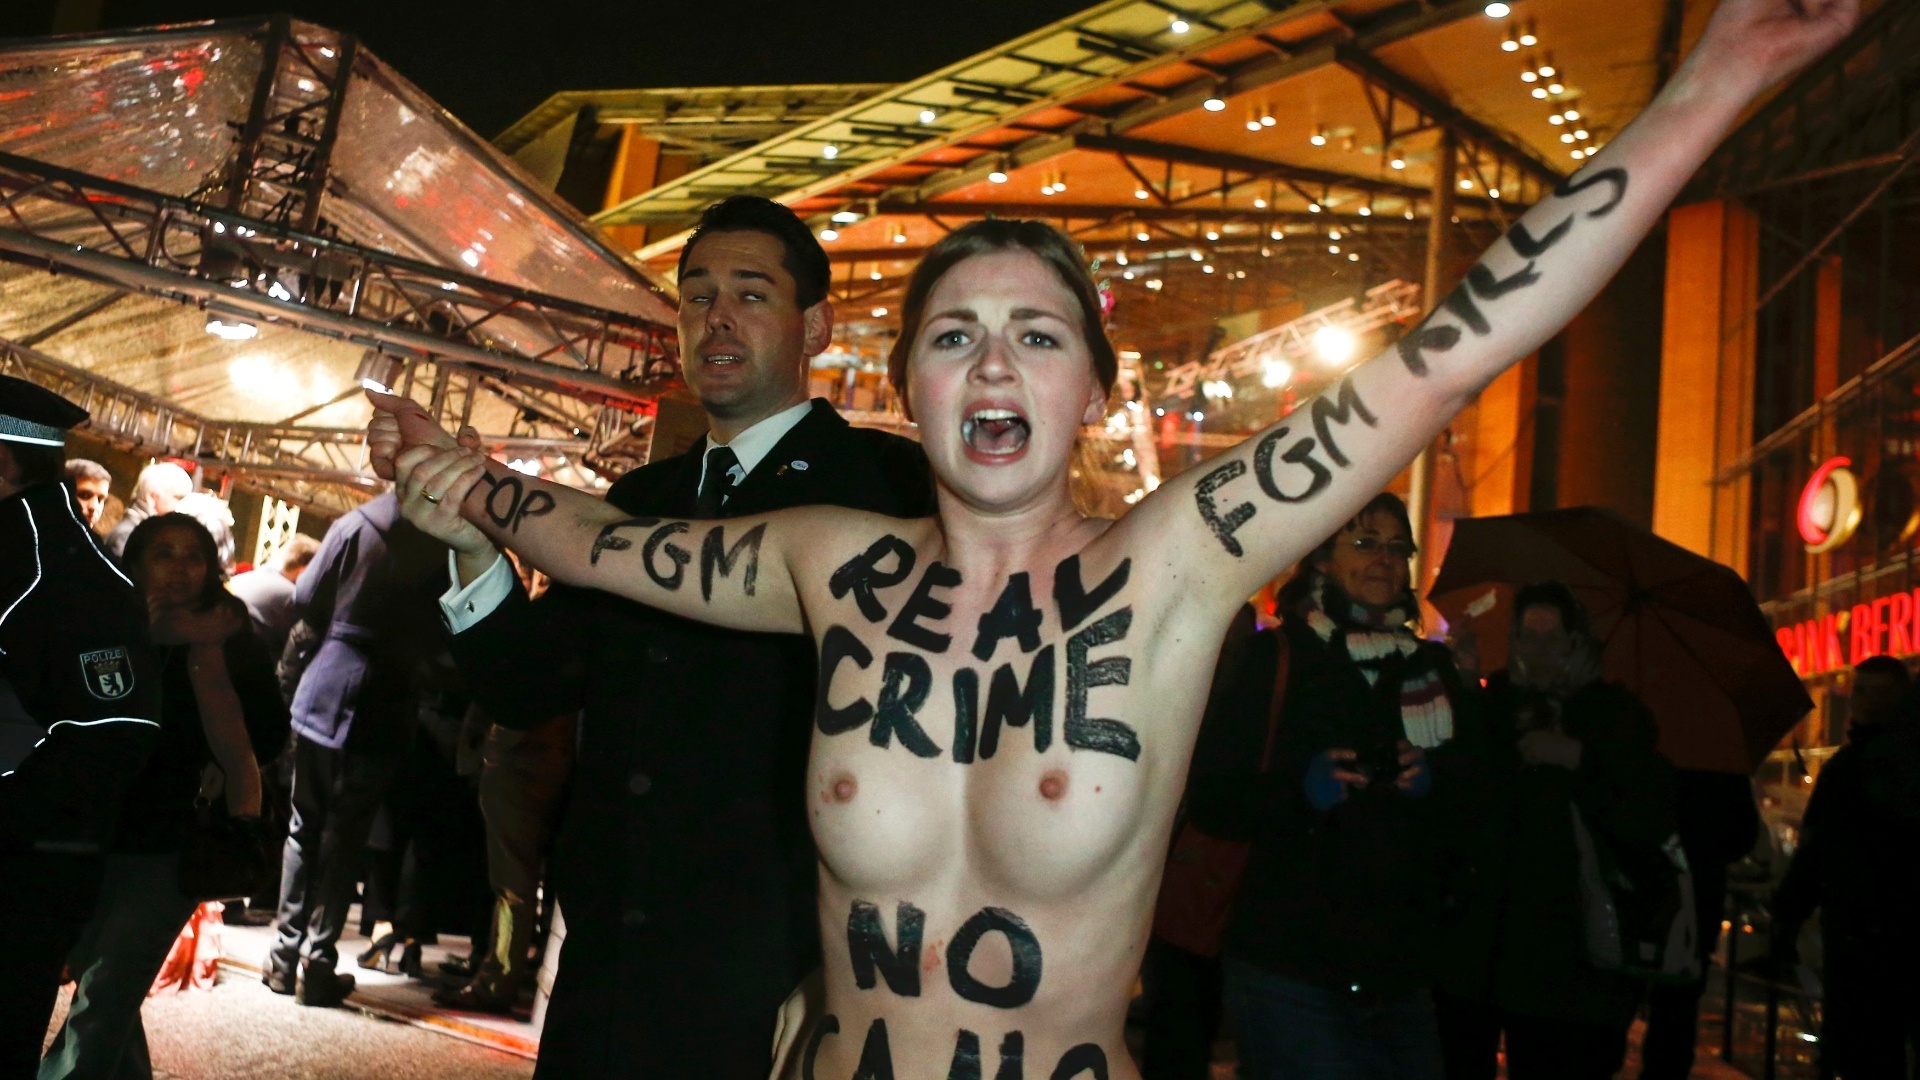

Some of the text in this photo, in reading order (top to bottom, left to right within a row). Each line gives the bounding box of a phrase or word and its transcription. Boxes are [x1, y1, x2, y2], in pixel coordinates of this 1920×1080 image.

[1194, 374, 1378, 558] FGM
[463, 470, 768, 604] TOP FGM
[829, 534, 1132, 662] REAL
[816, 604, 1141, 764] CRIME
[847, 900, 1042, 1009] NO
